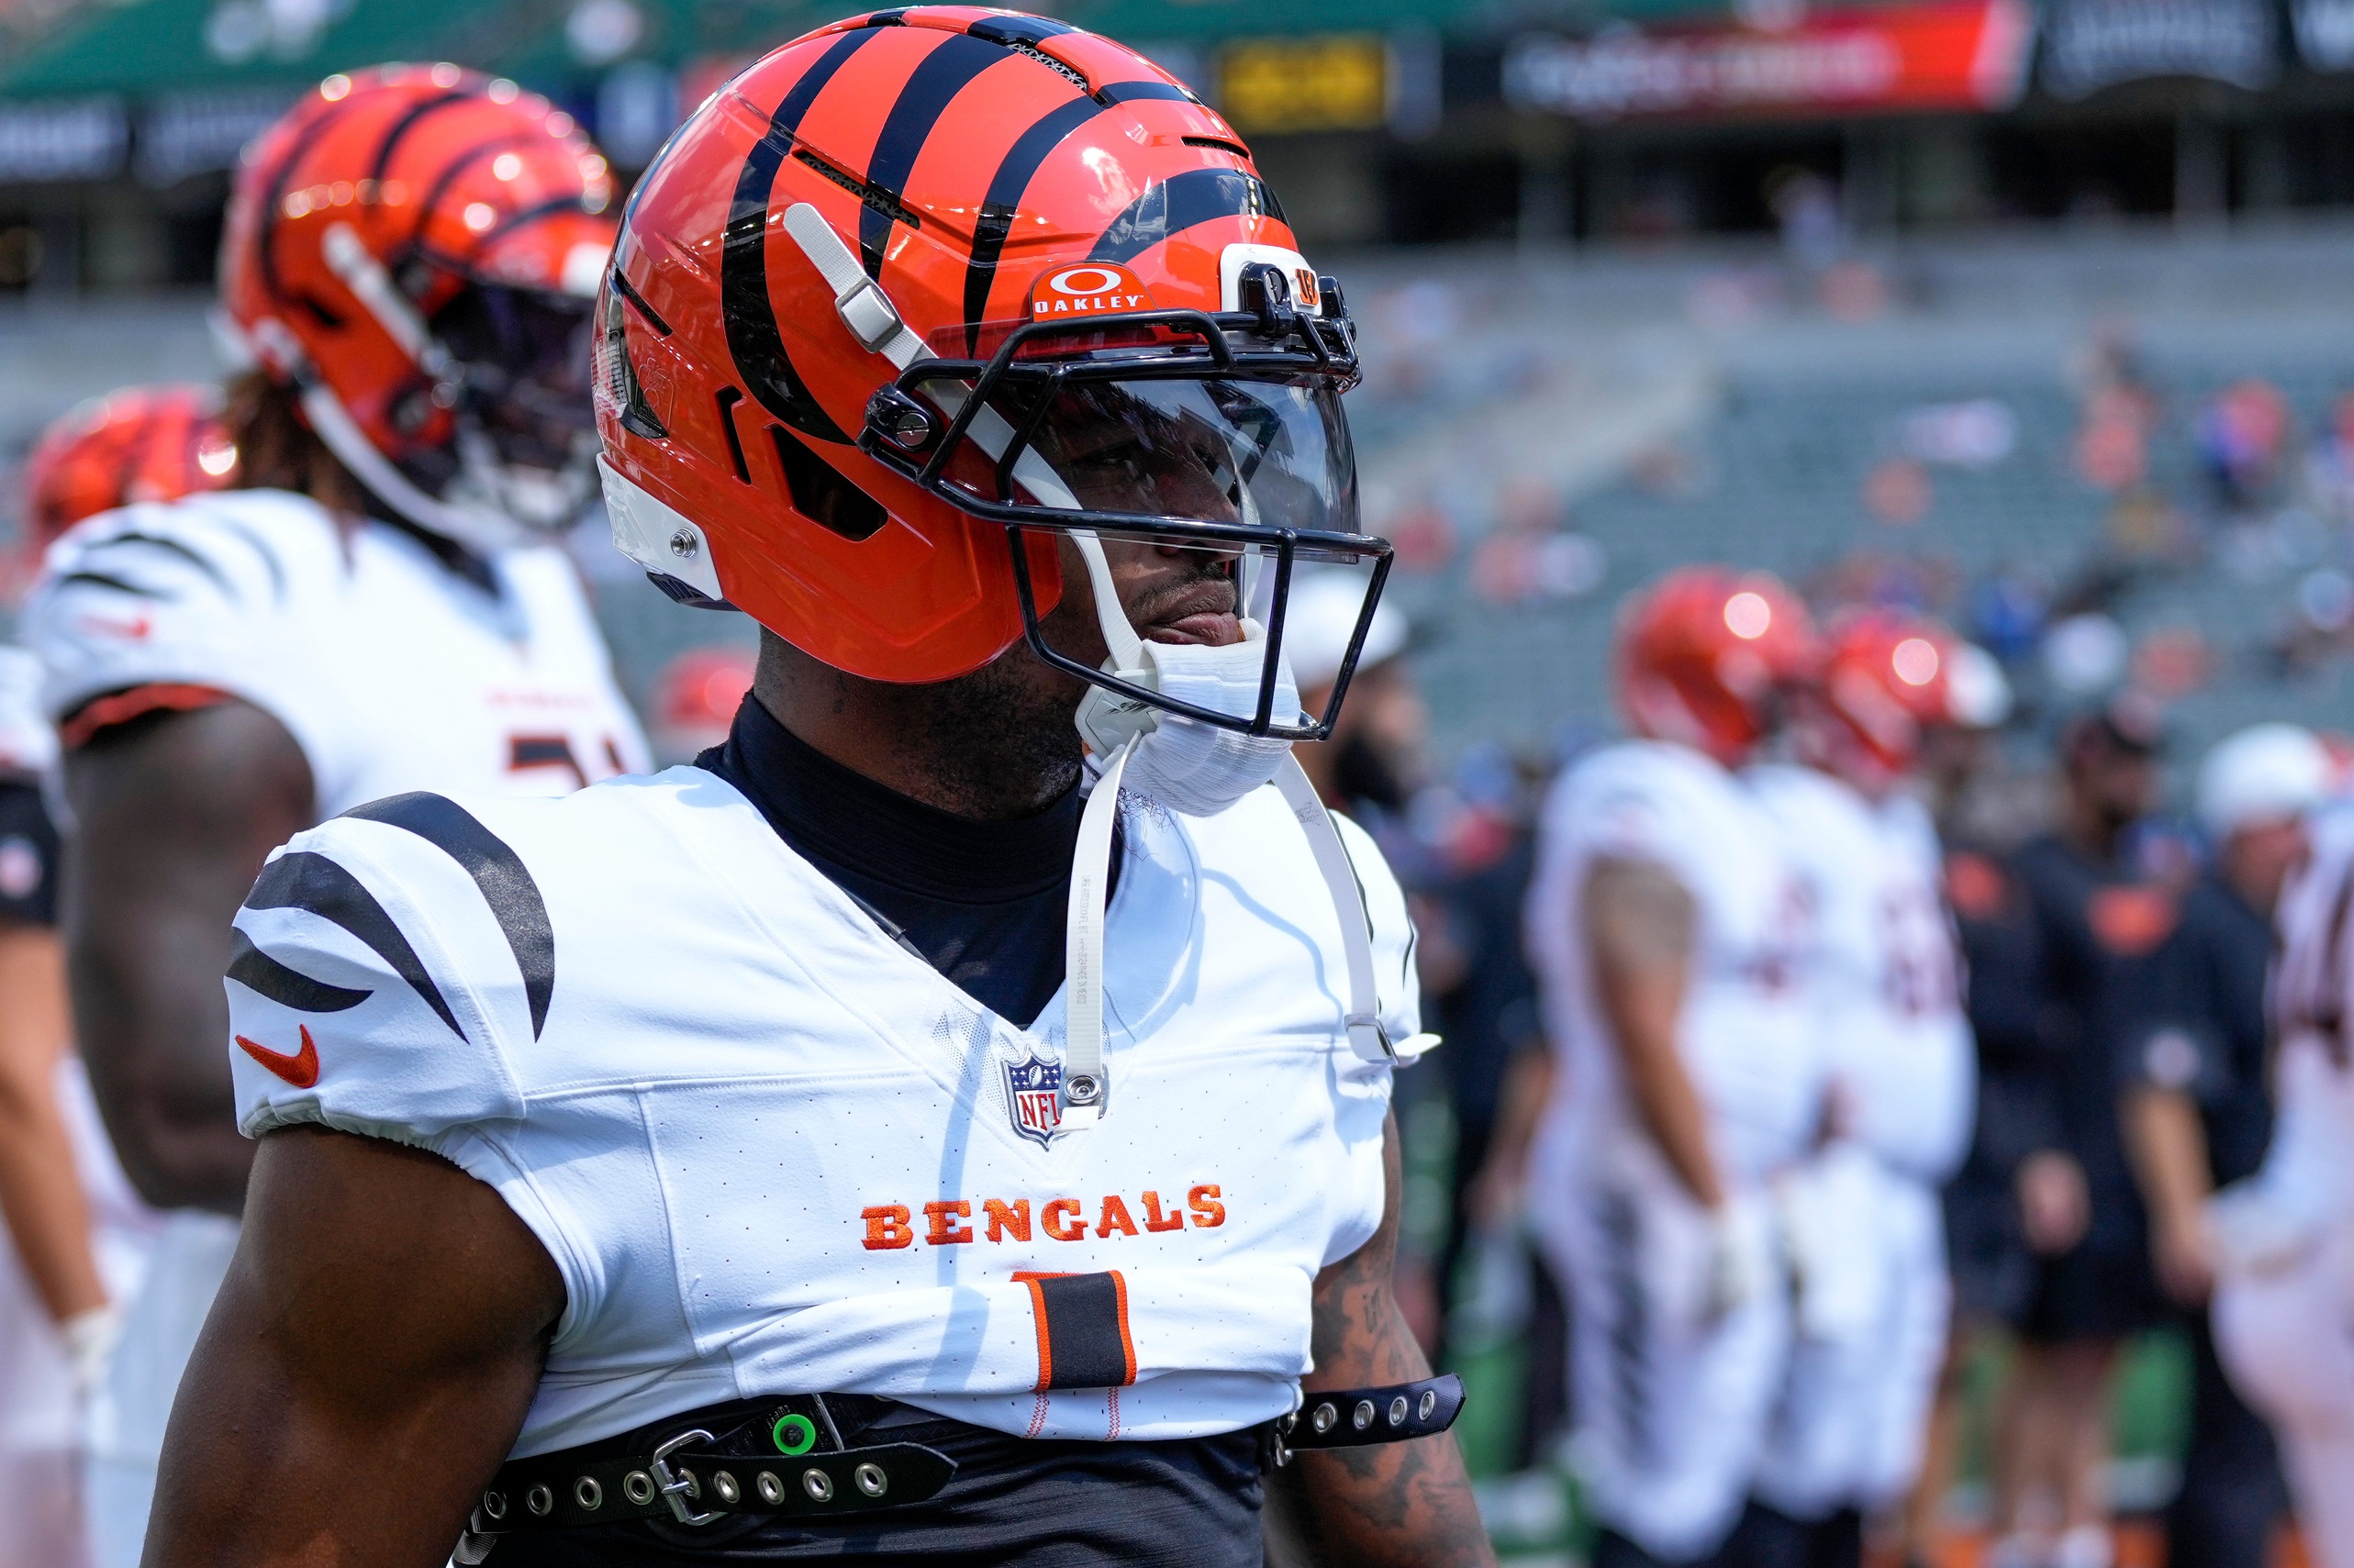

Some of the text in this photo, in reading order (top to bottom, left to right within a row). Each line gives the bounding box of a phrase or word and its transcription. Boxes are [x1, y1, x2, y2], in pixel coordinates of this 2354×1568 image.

[1034, 295, 1139, 314] OAKLEY
[1019, 1093, 1061, 1131] NFL
[861, 1184, 1226, 1251] BENGALS
